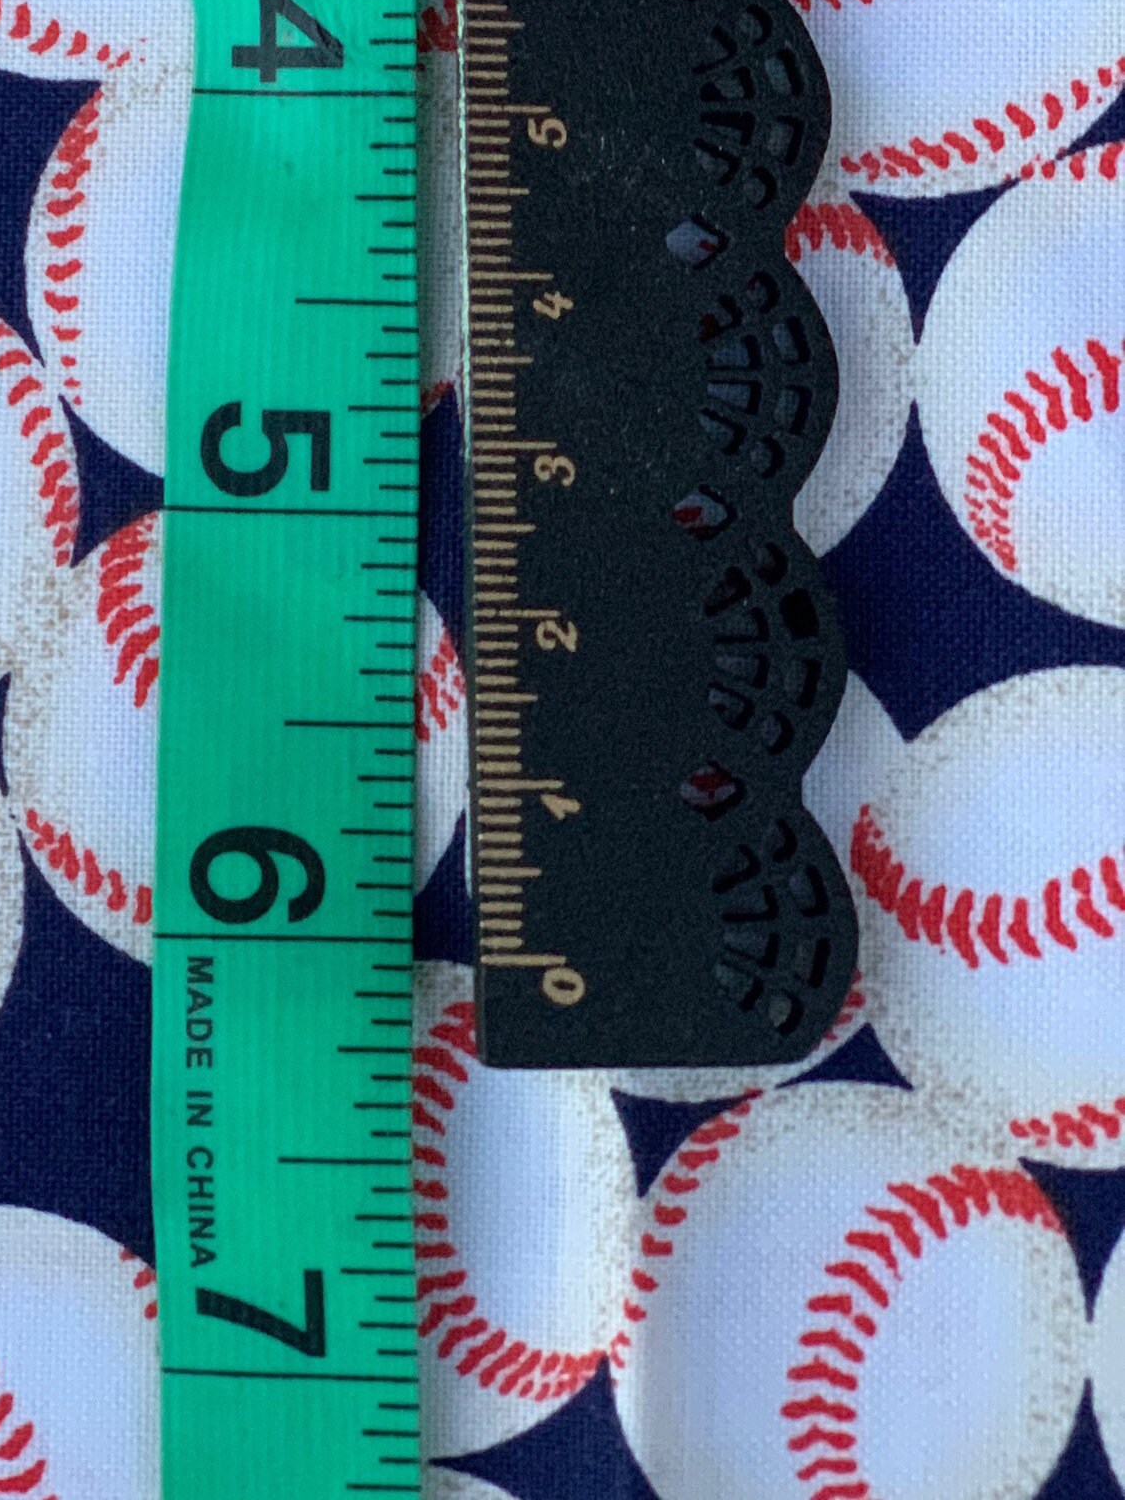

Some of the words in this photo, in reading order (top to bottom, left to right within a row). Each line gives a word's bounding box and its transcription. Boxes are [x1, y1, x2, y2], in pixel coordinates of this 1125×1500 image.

[528, 118, 567, 148] 5
[533, 291, 573, 319] 4
[200, 401, 331, 497] 5
[534, 455, 575, 486] 3
[536, 620, 577, 652] 2
[541, 790, 581, 820] 1
[189, 826, 326, 924] 6
[543, 968, 585, 1005] 0
[186, 956, 214, 1068] MADE
[187, 1091, 212, 1126] IN
[187, 1146, 216, 1267] CHINA
[196, 1269, 326, 1358] 7
